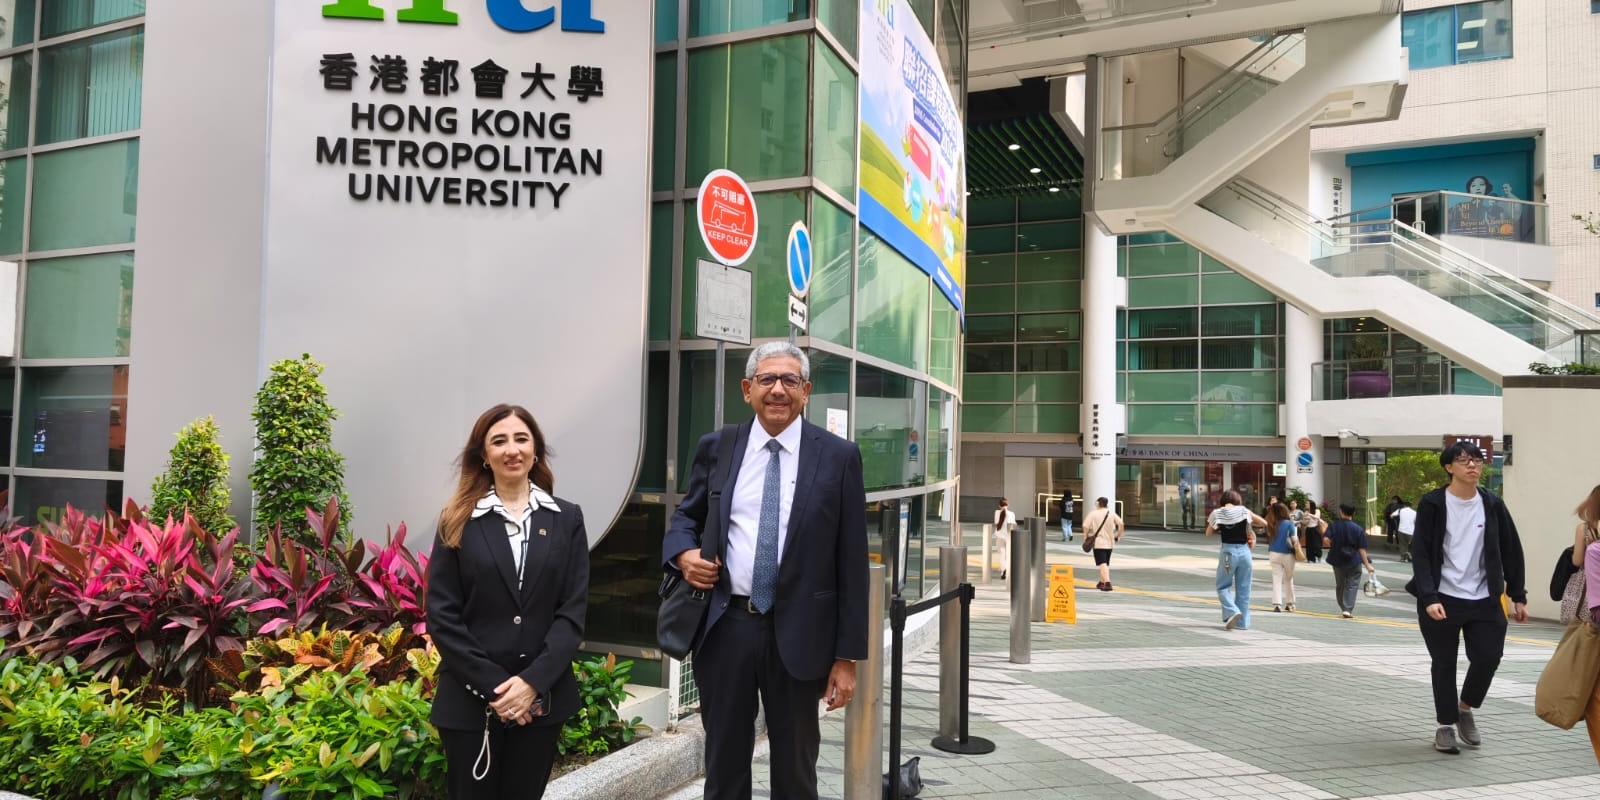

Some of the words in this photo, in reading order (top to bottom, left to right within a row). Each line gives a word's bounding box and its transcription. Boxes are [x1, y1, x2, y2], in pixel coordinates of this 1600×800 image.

[319, 53, 604, 103] 香港都會大學
[351, 102, 458, 133] HONG
[471, 108, 571, 140] KONG
[316, 136, 603, 176] METROPOLITAN
[349, 172, 570, 209] UNIVERSITY
[707, 230, 726, 241] KEEP
[727, 235, 749, 248] CLEAR
